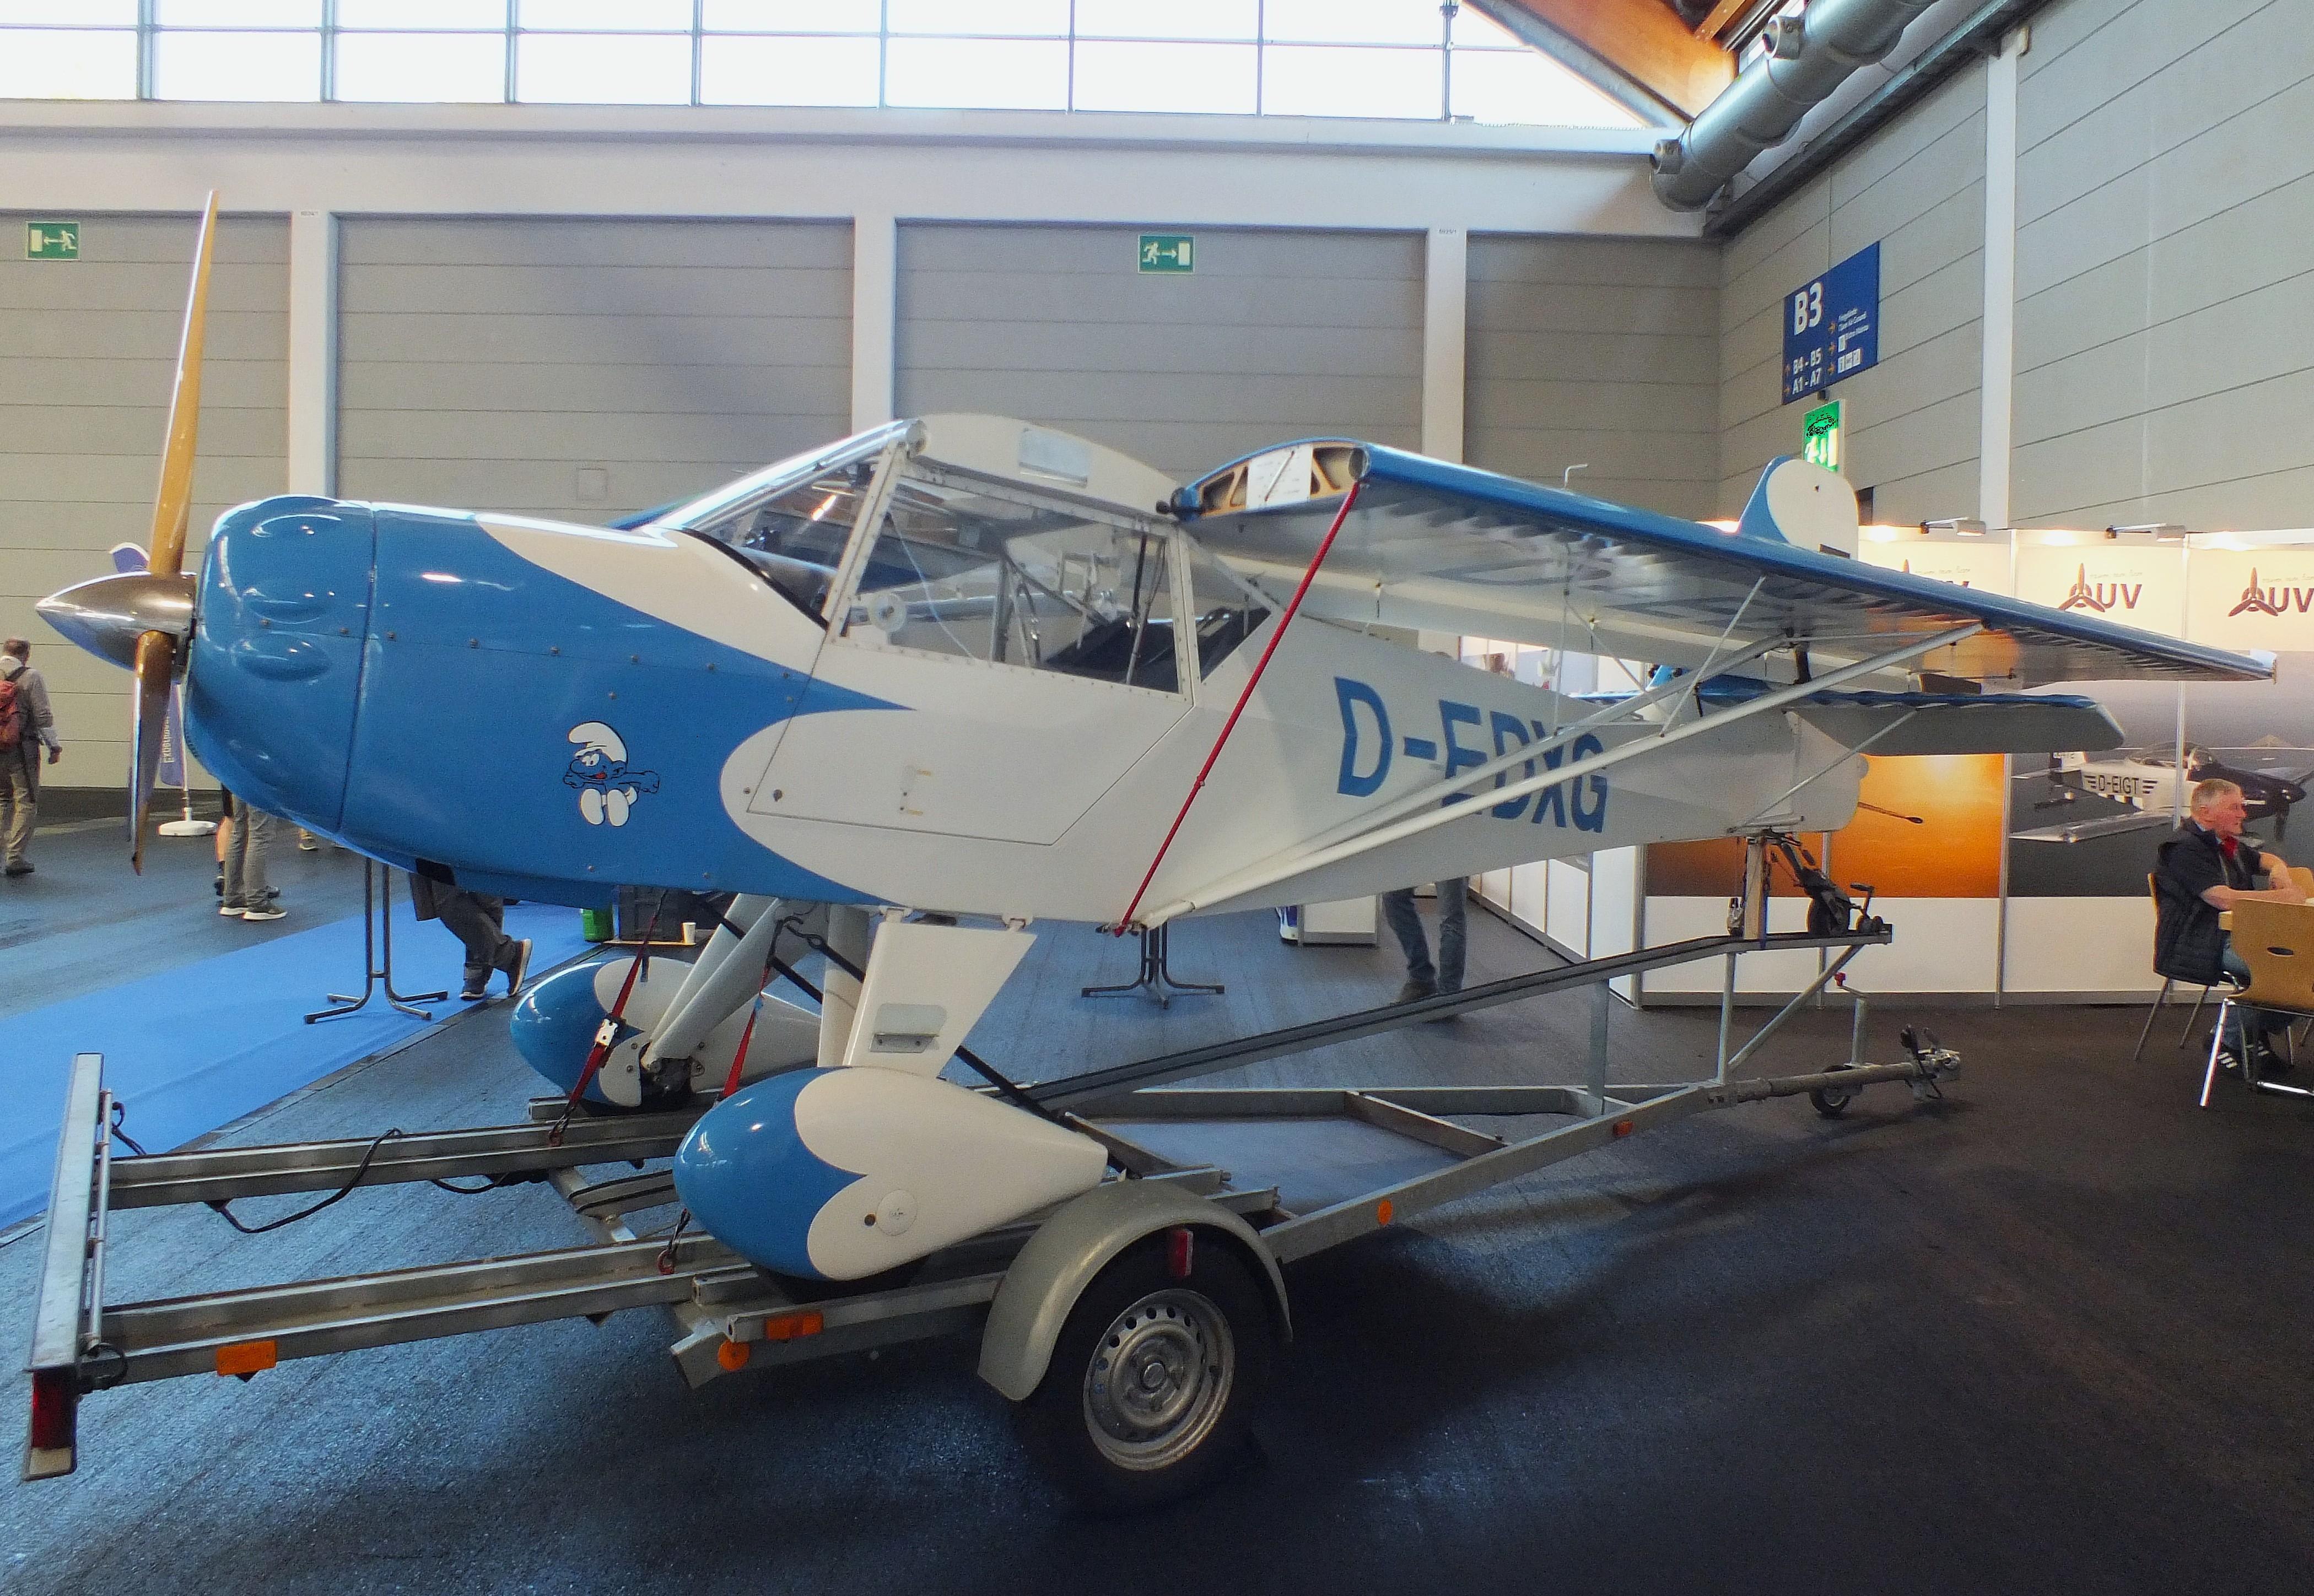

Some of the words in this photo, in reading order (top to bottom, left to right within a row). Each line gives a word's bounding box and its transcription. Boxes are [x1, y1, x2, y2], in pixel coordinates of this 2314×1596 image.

[1794, 283, 1822, 336] B3
[1793, 356, 1803, 375] B4
[1792, 376, 1803, 394] A1
[1810, 368, 1821, 387] A7
[1334, 677, 1608, 833] D-EDXG
[2098, 775, 2139, 794] D-EIGT
